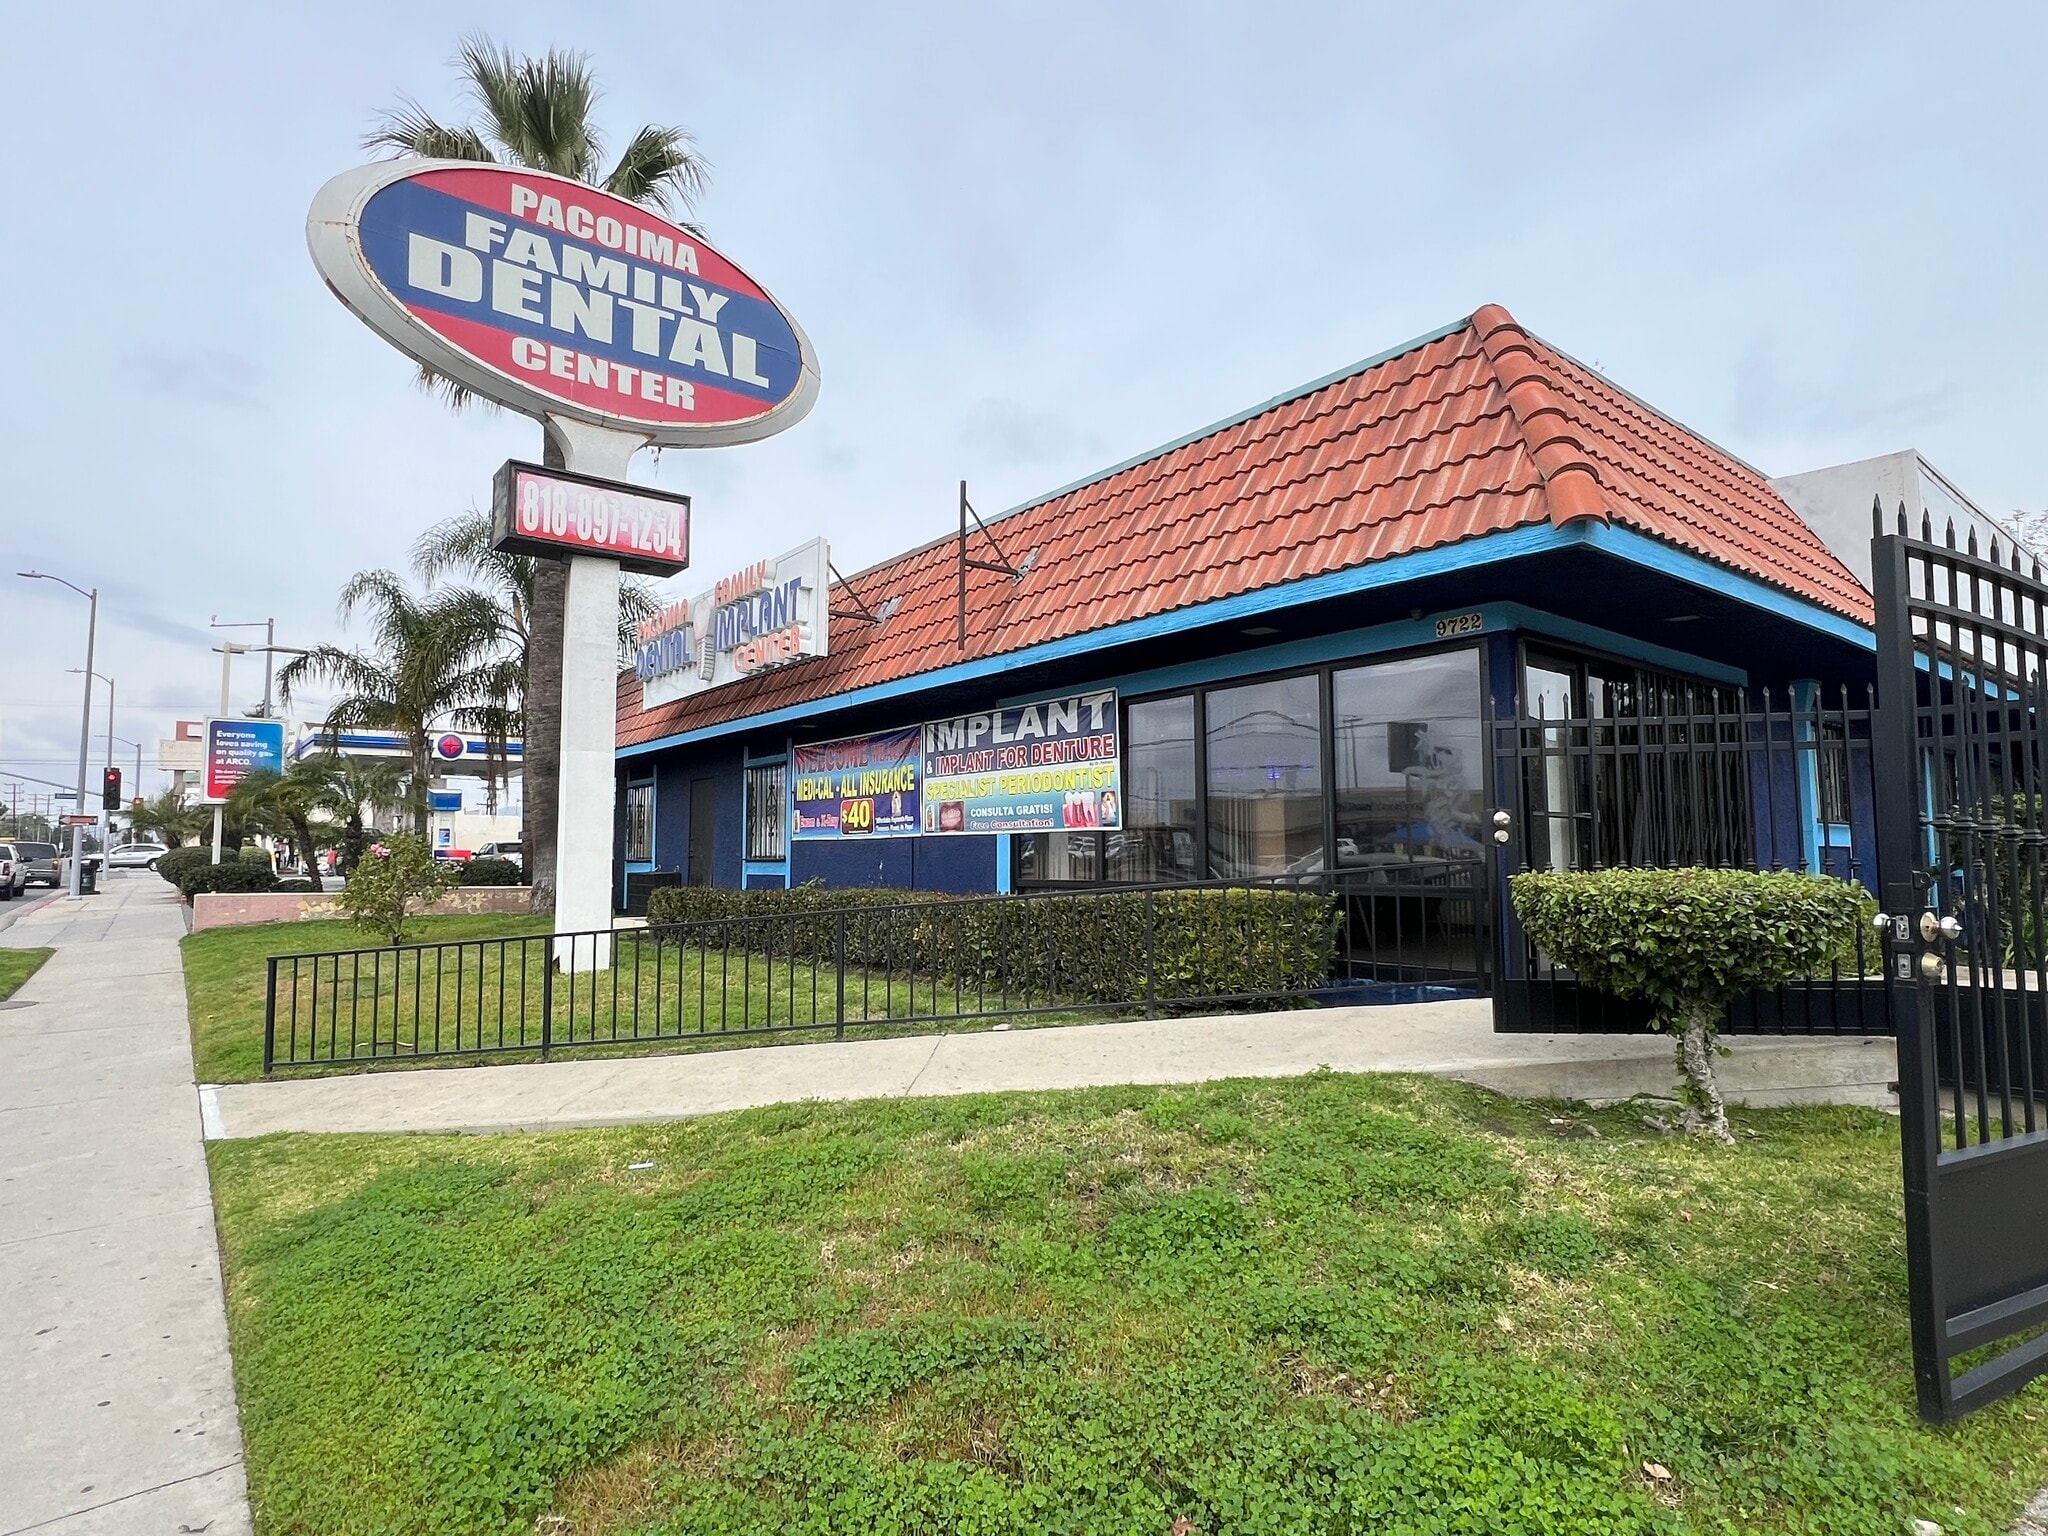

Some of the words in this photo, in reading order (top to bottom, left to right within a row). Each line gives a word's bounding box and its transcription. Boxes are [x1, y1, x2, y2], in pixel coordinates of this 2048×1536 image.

[511, 183, 699, 276] PACOIMA
[465, 211, 730, 324] FAMILY
[408, 232, 770, 389] DENTAL
[512, 336, 696, 411] CENTER
[522, 480, 682, 556] 818-897-1234
[714, 559, 767, 607] FAMILY
[636, 630, 690, 681] DENTAL
[714, 576, 802, 651] IMPLANT
[1436, 614, 1482, 636] 9722
[734, 624, 801, 673] CENTER
[216, 730, 256, 739] Everyone
[925, 692, 1114, 753] IMPLANT
[228, 749, 257, 757] quality
[240, 741, 268, 749] saving
[794, 737, 870, 775] WELCOME
[926, 760, 933, 775] &
[936, 749, 994, 776] IMPLANT
[996, 744, 1028, 771] FOR
[1031, 733, 1115, 766] DENTURE
[796, 776, 834, 801] MEDI-CAL
[840, 774, 858, 798] ALL
[860, 764, 915, 796] INSURANCE
[925, 777, 997, 801] SPECIALIST
[999, 764, 1116, 796] PERIODONTIST
[842, 800, 870, 828] $40
[969, 819, 990, 830] Free
[991, 818, 1055, 829] Consultation!
[970, 805, 1015, 818] CONSULTA
[1016, 803, 1053, 815] GRATIS!
